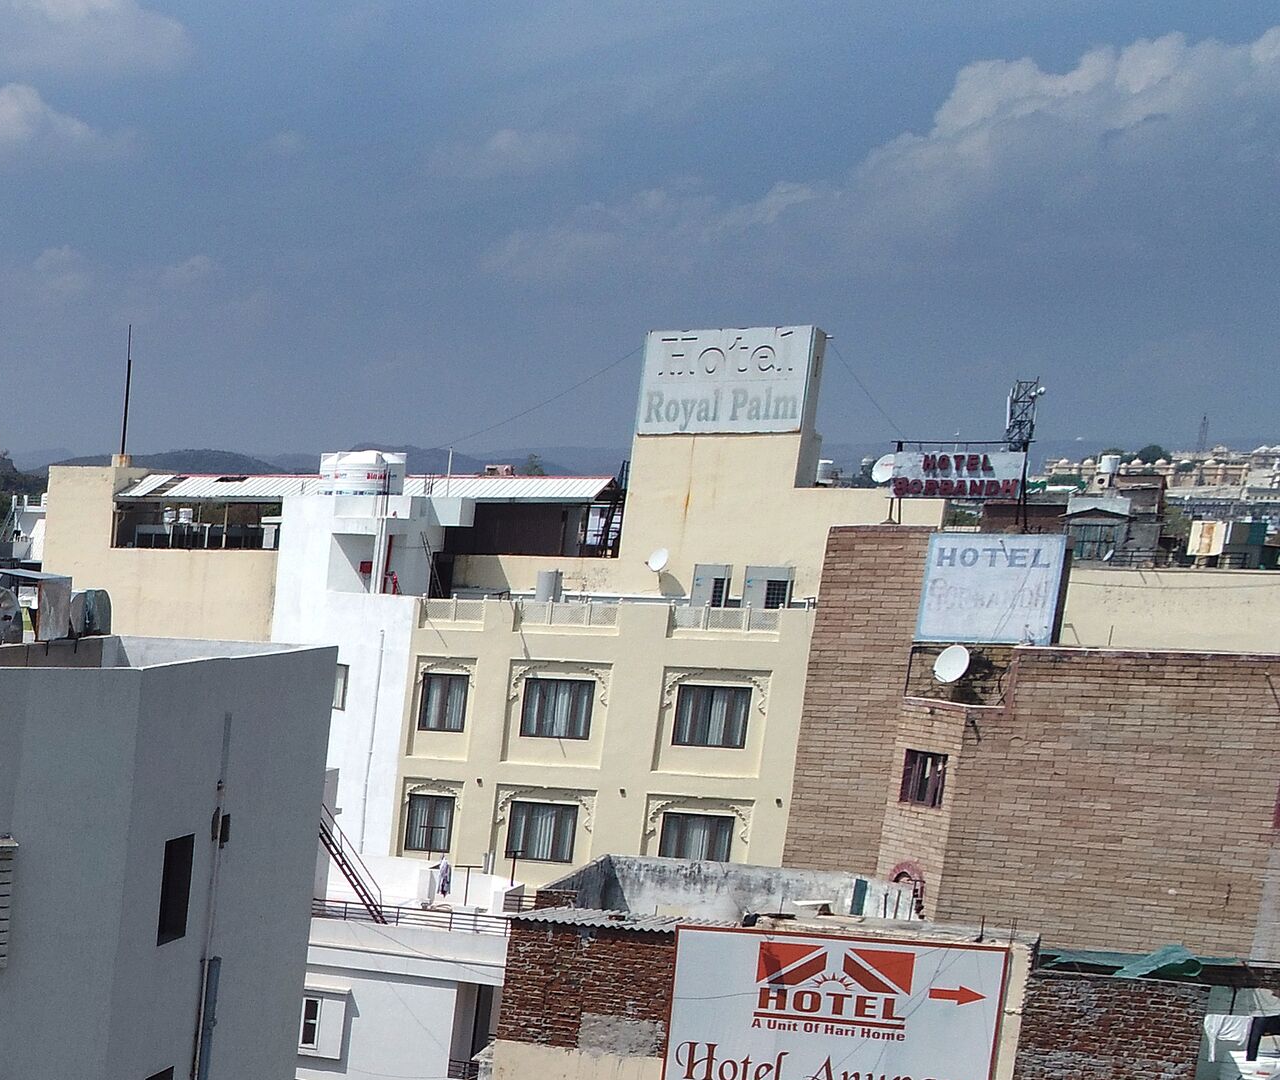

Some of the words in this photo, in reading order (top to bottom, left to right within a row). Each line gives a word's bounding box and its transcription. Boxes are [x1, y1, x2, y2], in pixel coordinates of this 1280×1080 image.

[657, 331, 794, 376] Hotel
[644, 388, 721, 431] Royal
[728, 387, 798, 421] Palm
[922, 454, 994, 474] HOTEL
[936, 547, 1051, 569] HOTEL
[757, 986, 906, 1022] HOTEL
[751, 1018, 763, 1029] A
[766, 1020, 798, 1033] Unit
[803, 1022, 820, 1034] Of
[824, 1023, 856, 1038] Hari
[860, 1027, 906, 1042] Home
